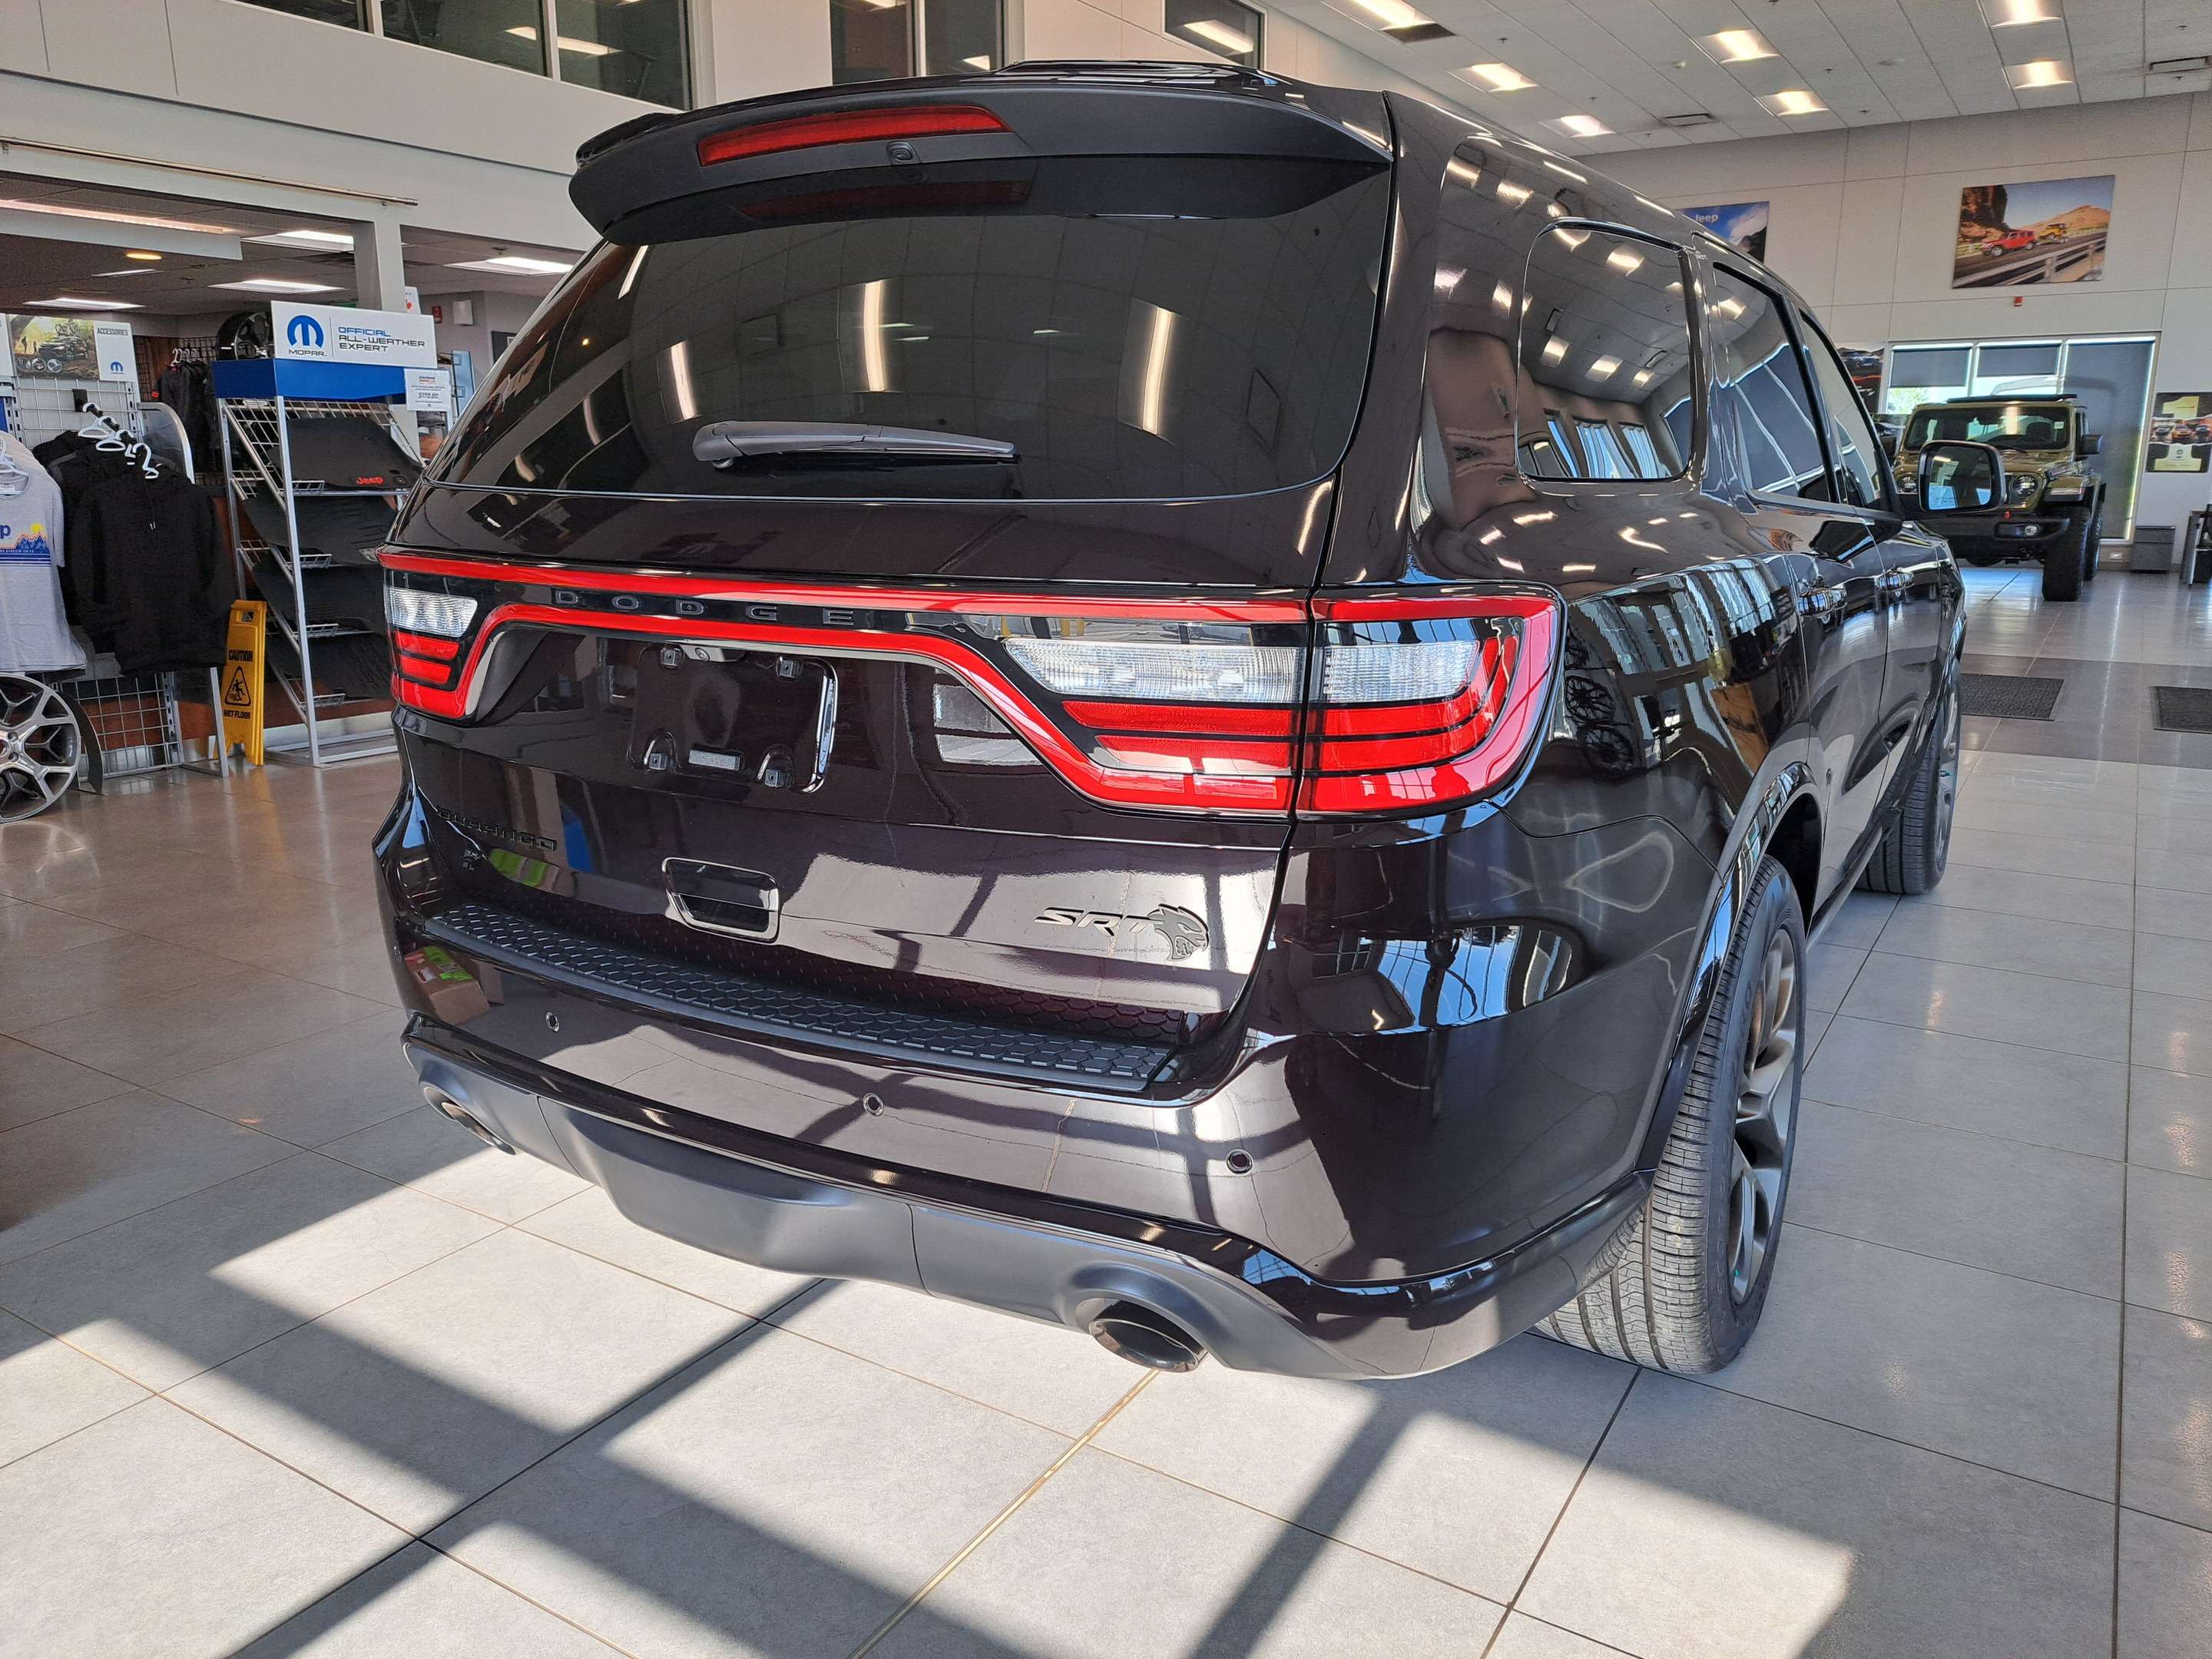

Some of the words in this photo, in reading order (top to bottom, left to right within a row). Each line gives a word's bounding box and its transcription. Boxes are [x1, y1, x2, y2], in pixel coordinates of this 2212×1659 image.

[97, 327, 128, 336] ACCESSORIES
[338, 326, 391, 336] OFFICIAL
[339, 335, 426, 347] ALL-WEATHER
[339, 343, 388, 352] EXPERT
[356, 476, 383, 485] Jeep
[555, 590, 854, 625] DODGE
[228, 650, 253, 662] CAUTION
[234, 710, 250, 720] FLOOR
[1034, 906, 1151, 936] SRT
